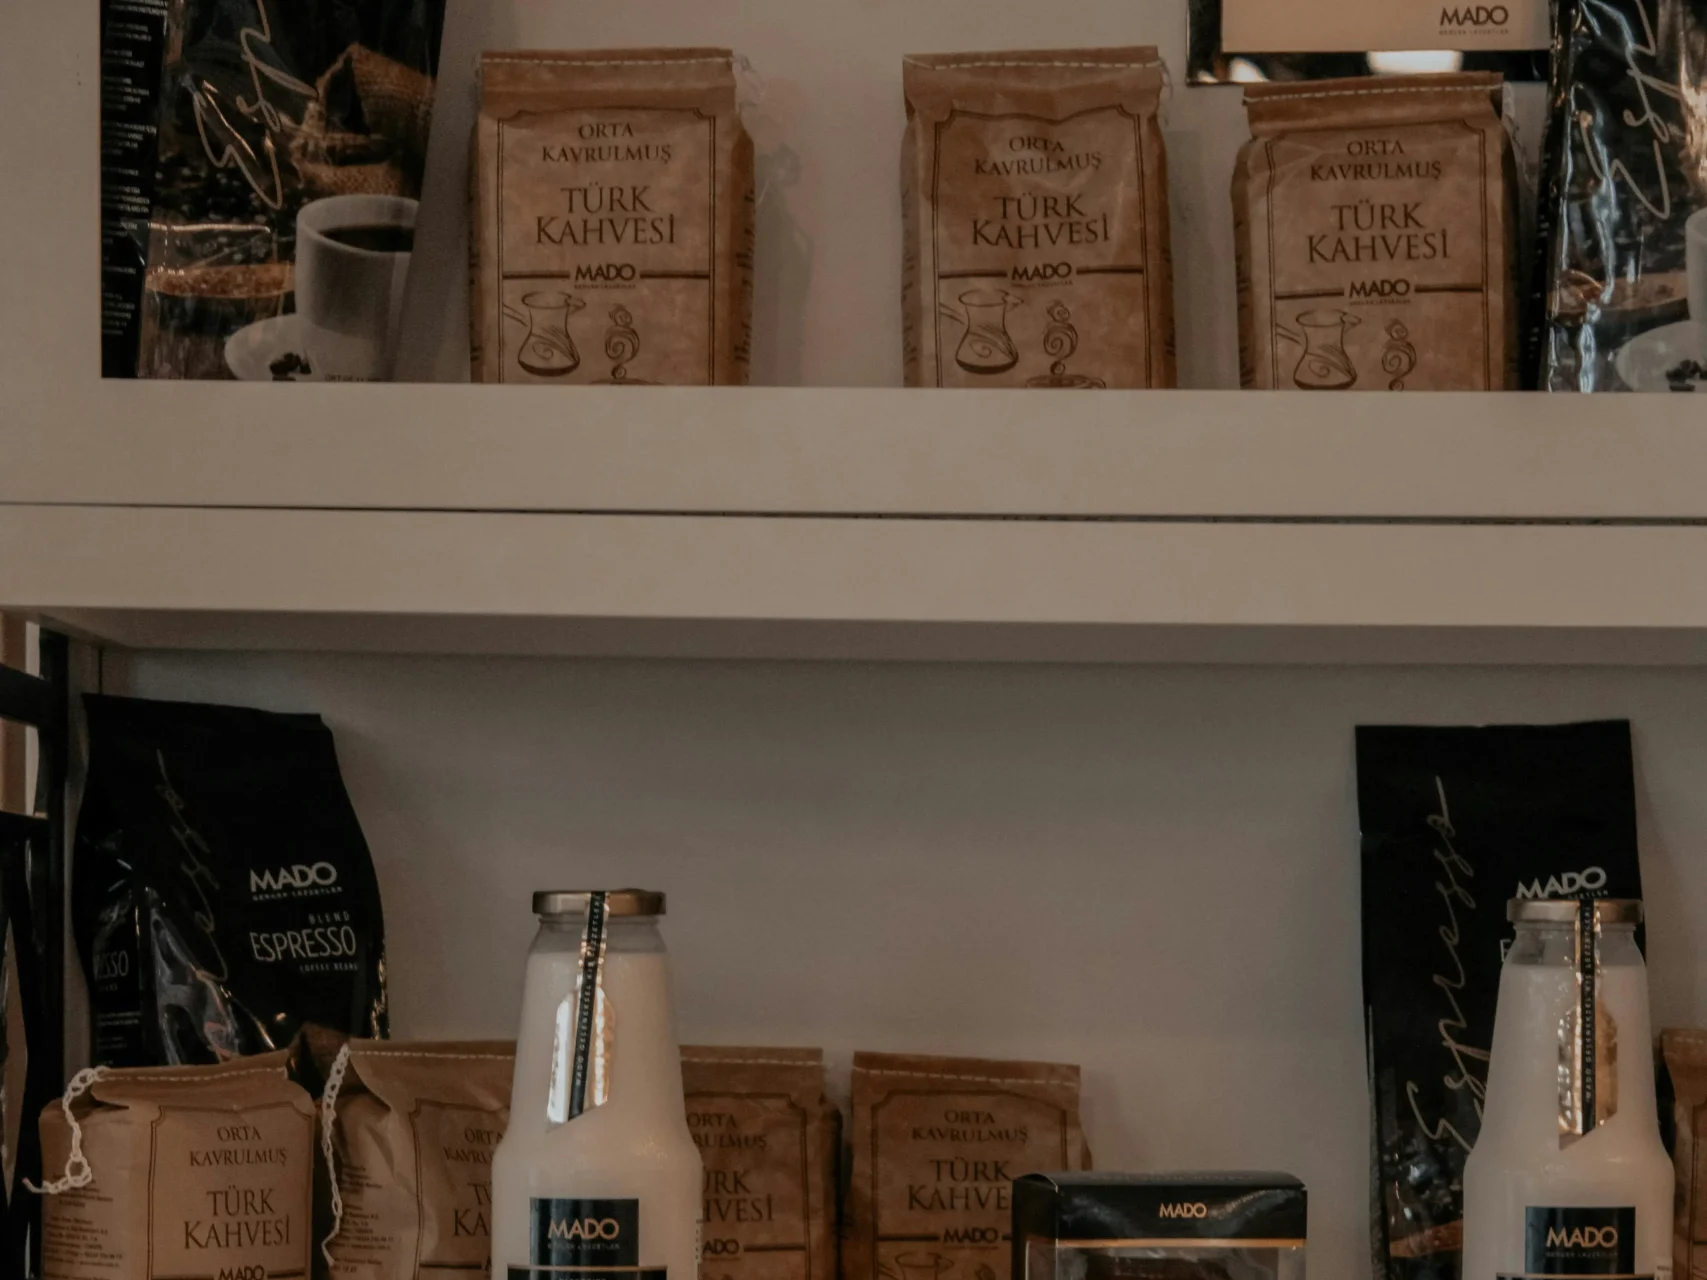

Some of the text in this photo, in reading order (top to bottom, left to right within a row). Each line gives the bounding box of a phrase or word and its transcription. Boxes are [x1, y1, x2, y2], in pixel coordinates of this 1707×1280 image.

[1440, 5, 1508, 26] MADO
[578, 123, 634, 139] ORTA
[542, 145, 672, 164] KAVRULMUŞ
[1009, 136, 1065, 152] ORTA
[1347, 139, 1404, 156] ORTA
[974, 152, 1102, 176] KAVRULMUŞ
[1310, 161, 1442, 181] KAVRULMUŞ
[560, 181, 653, 213] TÜRK
[994, 192, 1087, 221] TÜRK
[1330, 199, 1426, 231] TÜRK
[535, 213, 675, 244] KAHVESİ
[972, 212, 1111, 249] KAHVESİ
[1307, 228, 1451, 263] KAHVESİ
[575, 263, 636, 281] MADO
[1011, 262, 1072, 281] MADO
[1350, 278, 1410, 297] MADO
[249, 861, 338, 893] MADO
[1516, 866, 1607, 898] MADO
[249, 925, 356, 962] ESPRESSO
[687, 1112, 737, 1128] ORTA
[944, 1109, 995, 1124] ORTA
[217, 1125, 262, 1141] ORTA
[912, 1125, 1028, 1143] KAVRULMUŞ
[189, 1148, 287, 1167] KAVRULMUŞ
[928, 1156, 1013, 1181] TÜRK
[206, 1185, 275, 1217] TÜRK
[908, 1184, 1009, 1210] KAHVE
[1159, 1202, 1208, 1219] MADO
[184, 1214, 291, 1250] KAHVESİ
[548, 1217, 620, 1240] MADO
[943, 1227, 998, 1243] MADO
[1546, 1226, 1618, 1248] MADO
[703, 1238, 740, 1254] ADO
